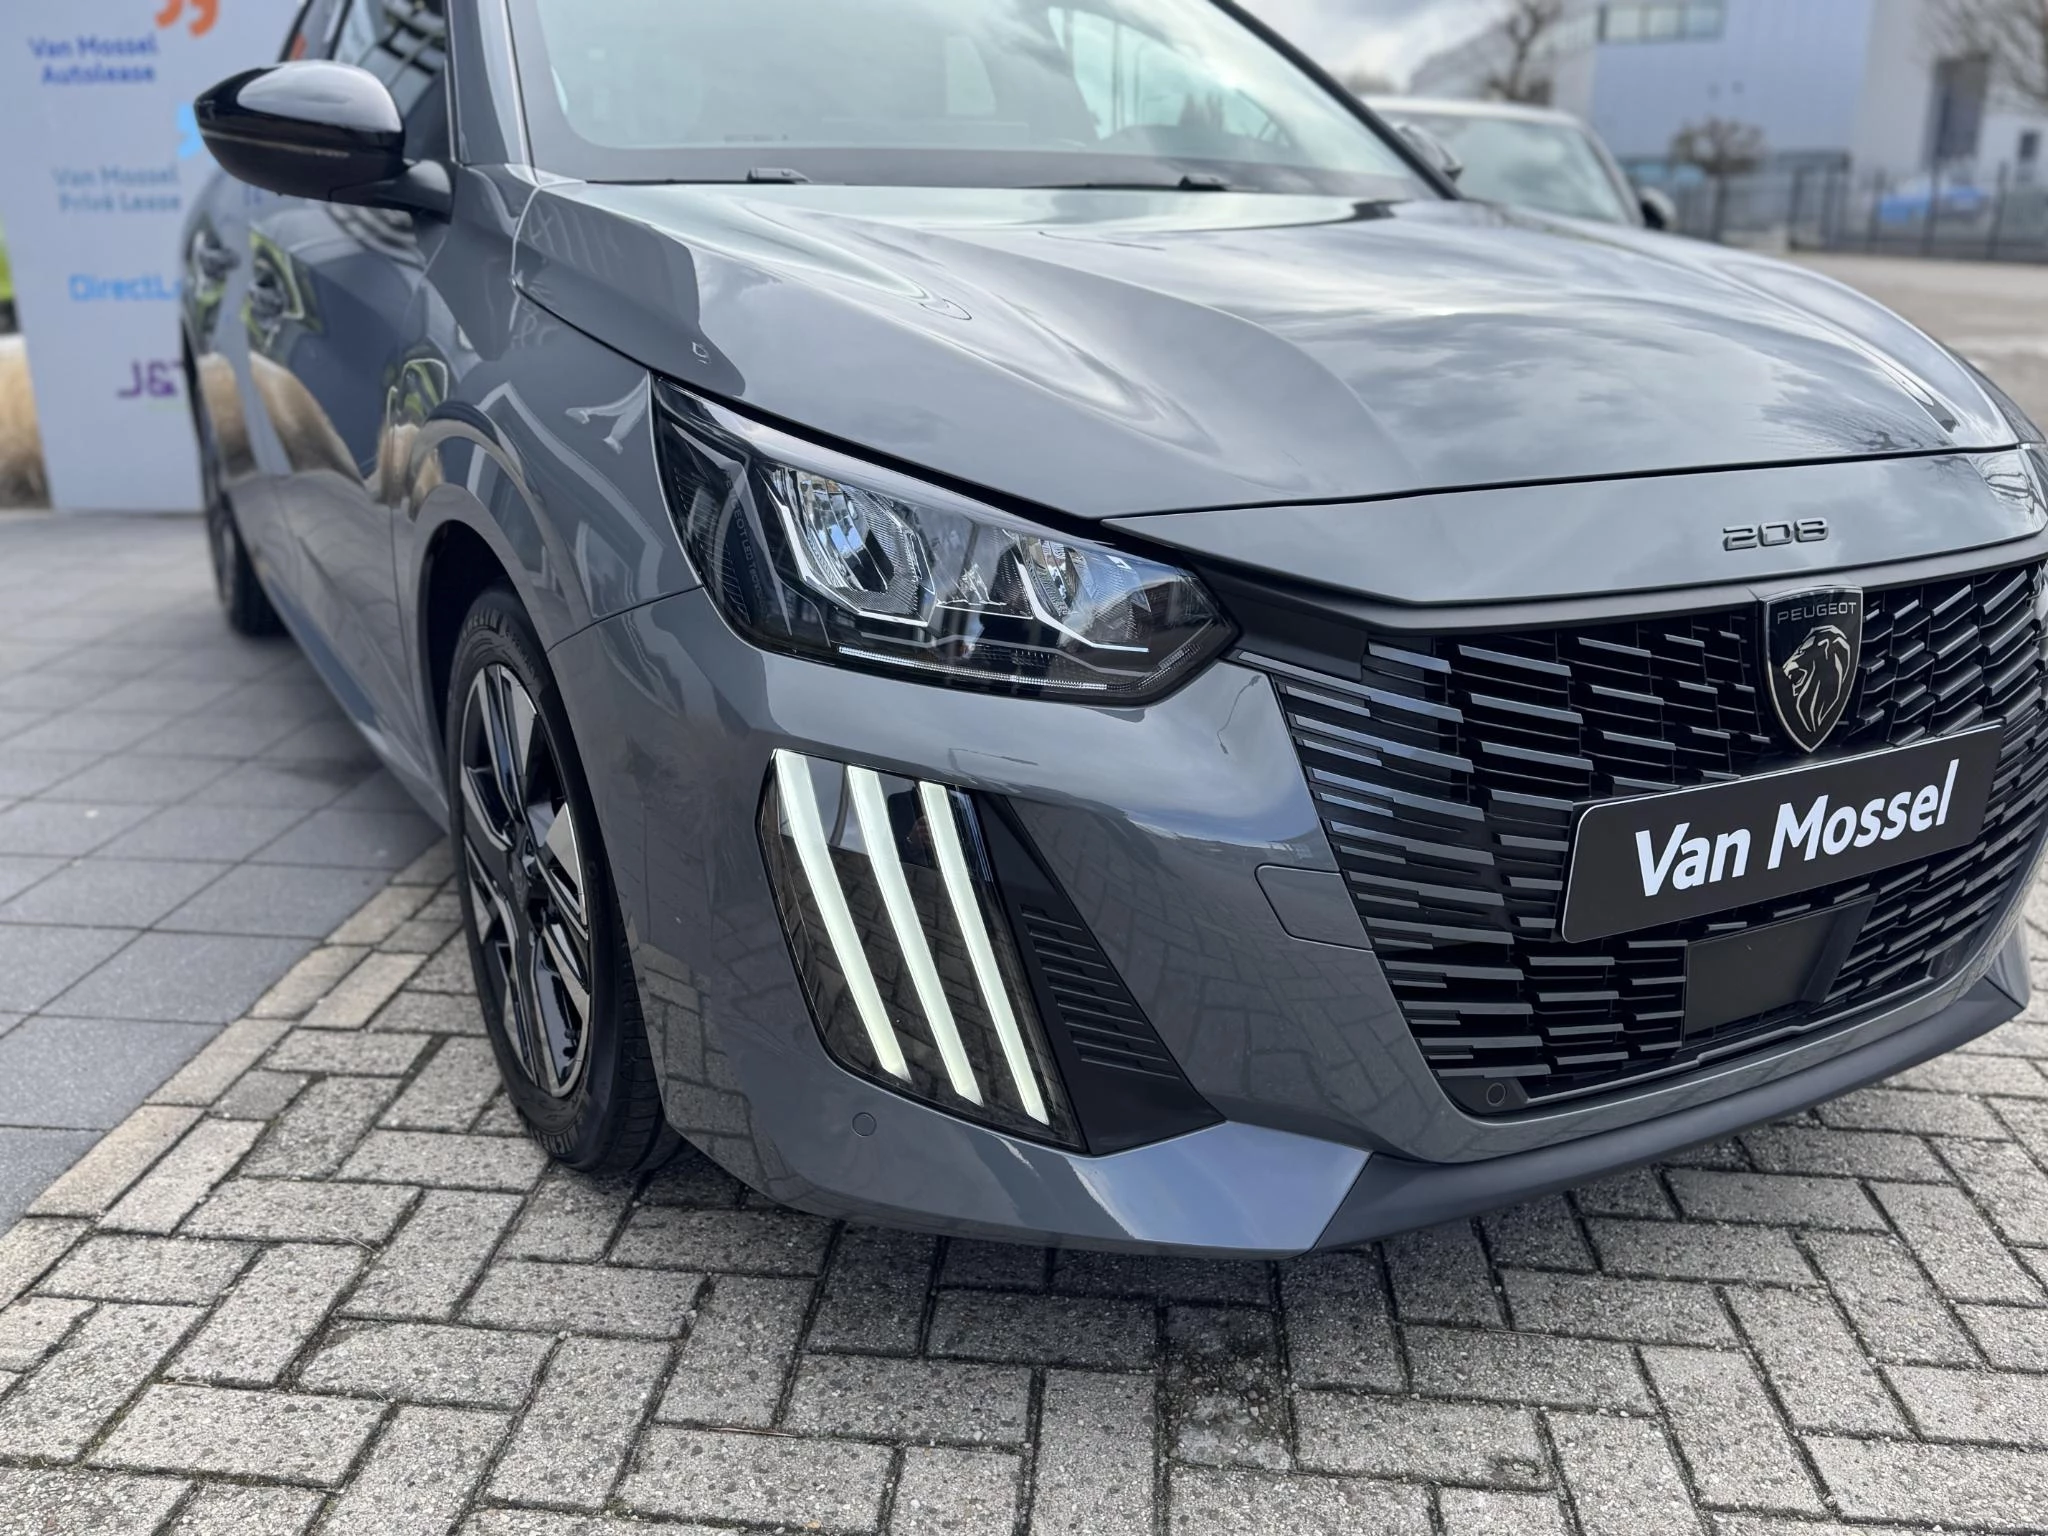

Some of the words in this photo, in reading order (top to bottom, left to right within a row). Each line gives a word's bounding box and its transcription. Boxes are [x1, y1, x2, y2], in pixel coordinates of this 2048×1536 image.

[28, 36, 71, 58] Van
[76, 31, 158, 57] Mossel
[42, 62, 155, 85] Autolease
[51, 165, 95, 187] Van
[98, 163, 180, 187] Mossel
[119, 192, 181, 213] Lease
[1722, 517, 1829, 551] 208
[1777, 602, 1857, 624] PEUGEOT
[1634, 822, 1751, 897] Van
[1767, 759, 1960, 870] Mossel
